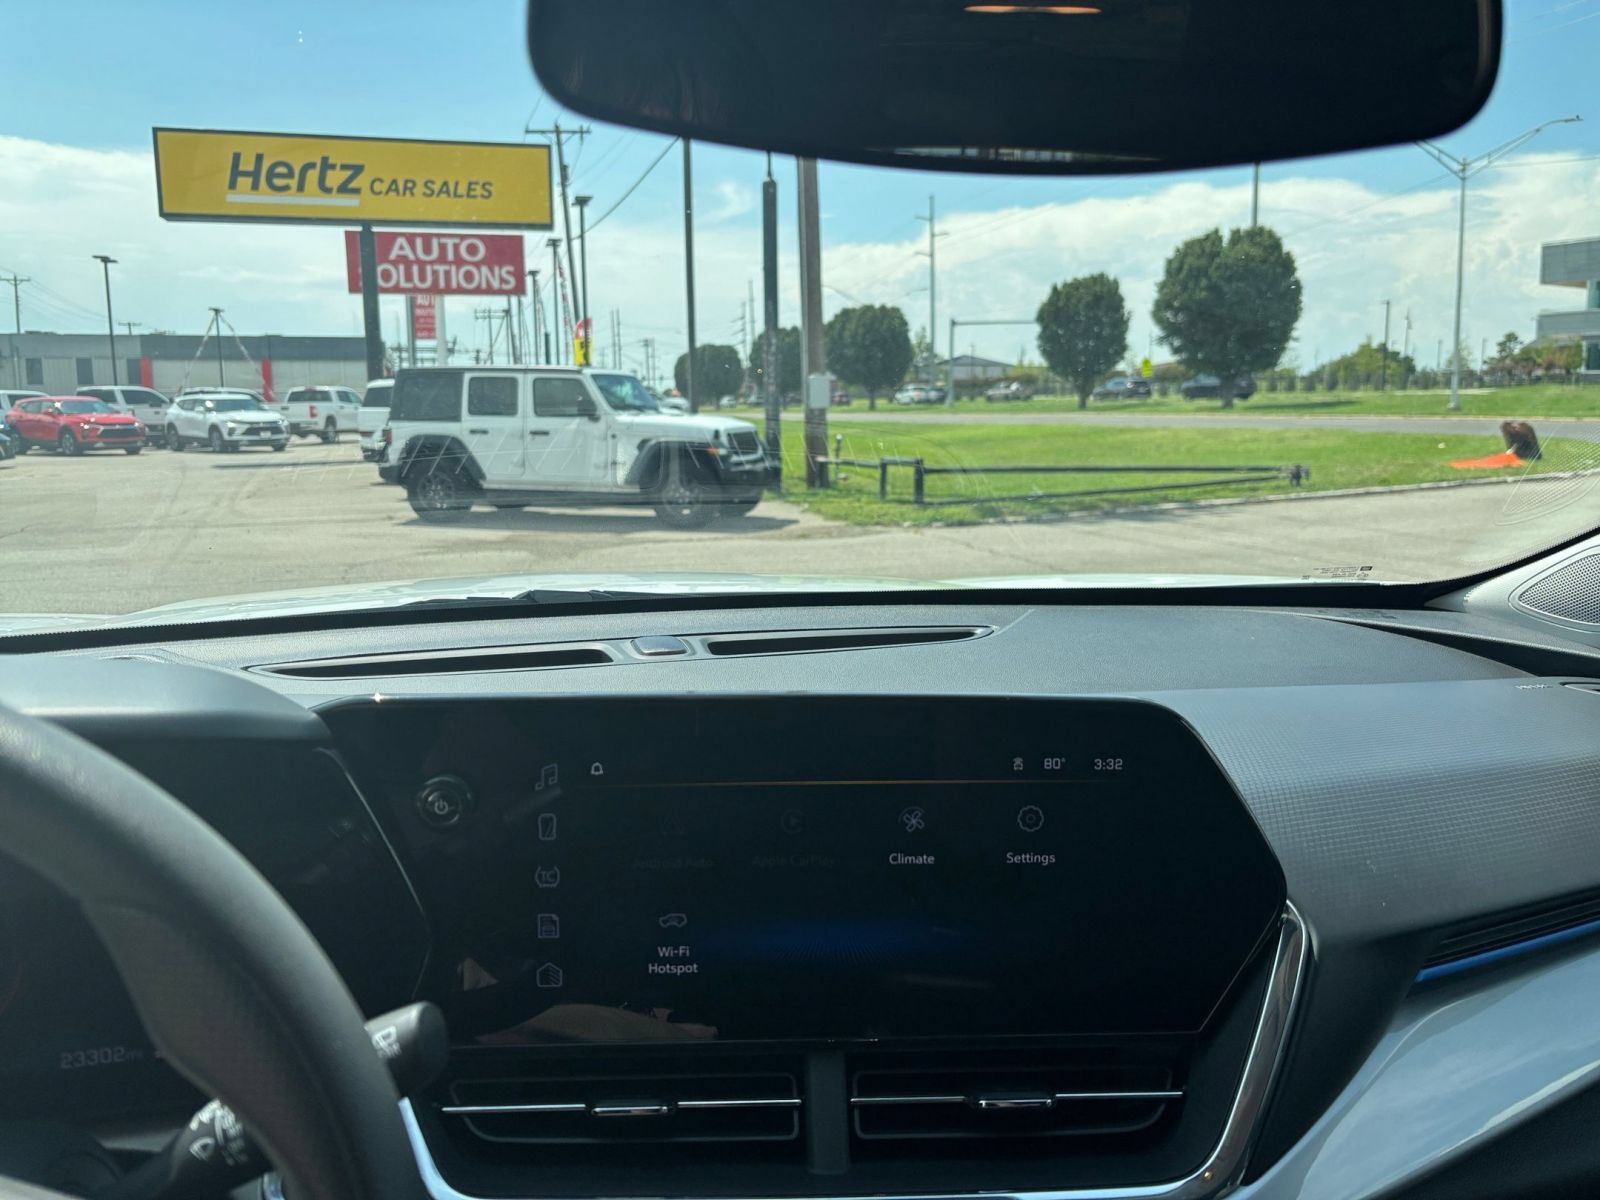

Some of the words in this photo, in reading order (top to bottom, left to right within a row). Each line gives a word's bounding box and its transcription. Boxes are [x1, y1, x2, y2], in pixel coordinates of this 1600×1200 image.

[227, 152, 365, 195] Hertz
[370, 177, 416, 197] CAR
[423, 179, 493, 199] SALES
[388, 236, 487, 263] AUTO
[376, 263, 516, 290] OLUTIONS
[1044, 757, 1066, 770] 80°
[1093, 758, 1124, 771] 3:32
[888, 853, 935, 865] Climate
[1005, 852, 1056, 866] Settings
[657, 945, 690, 957] Wi-Fi
[648, 962, 698, 976] Hotspot
[60, 1046, 126, 1069] 23302
